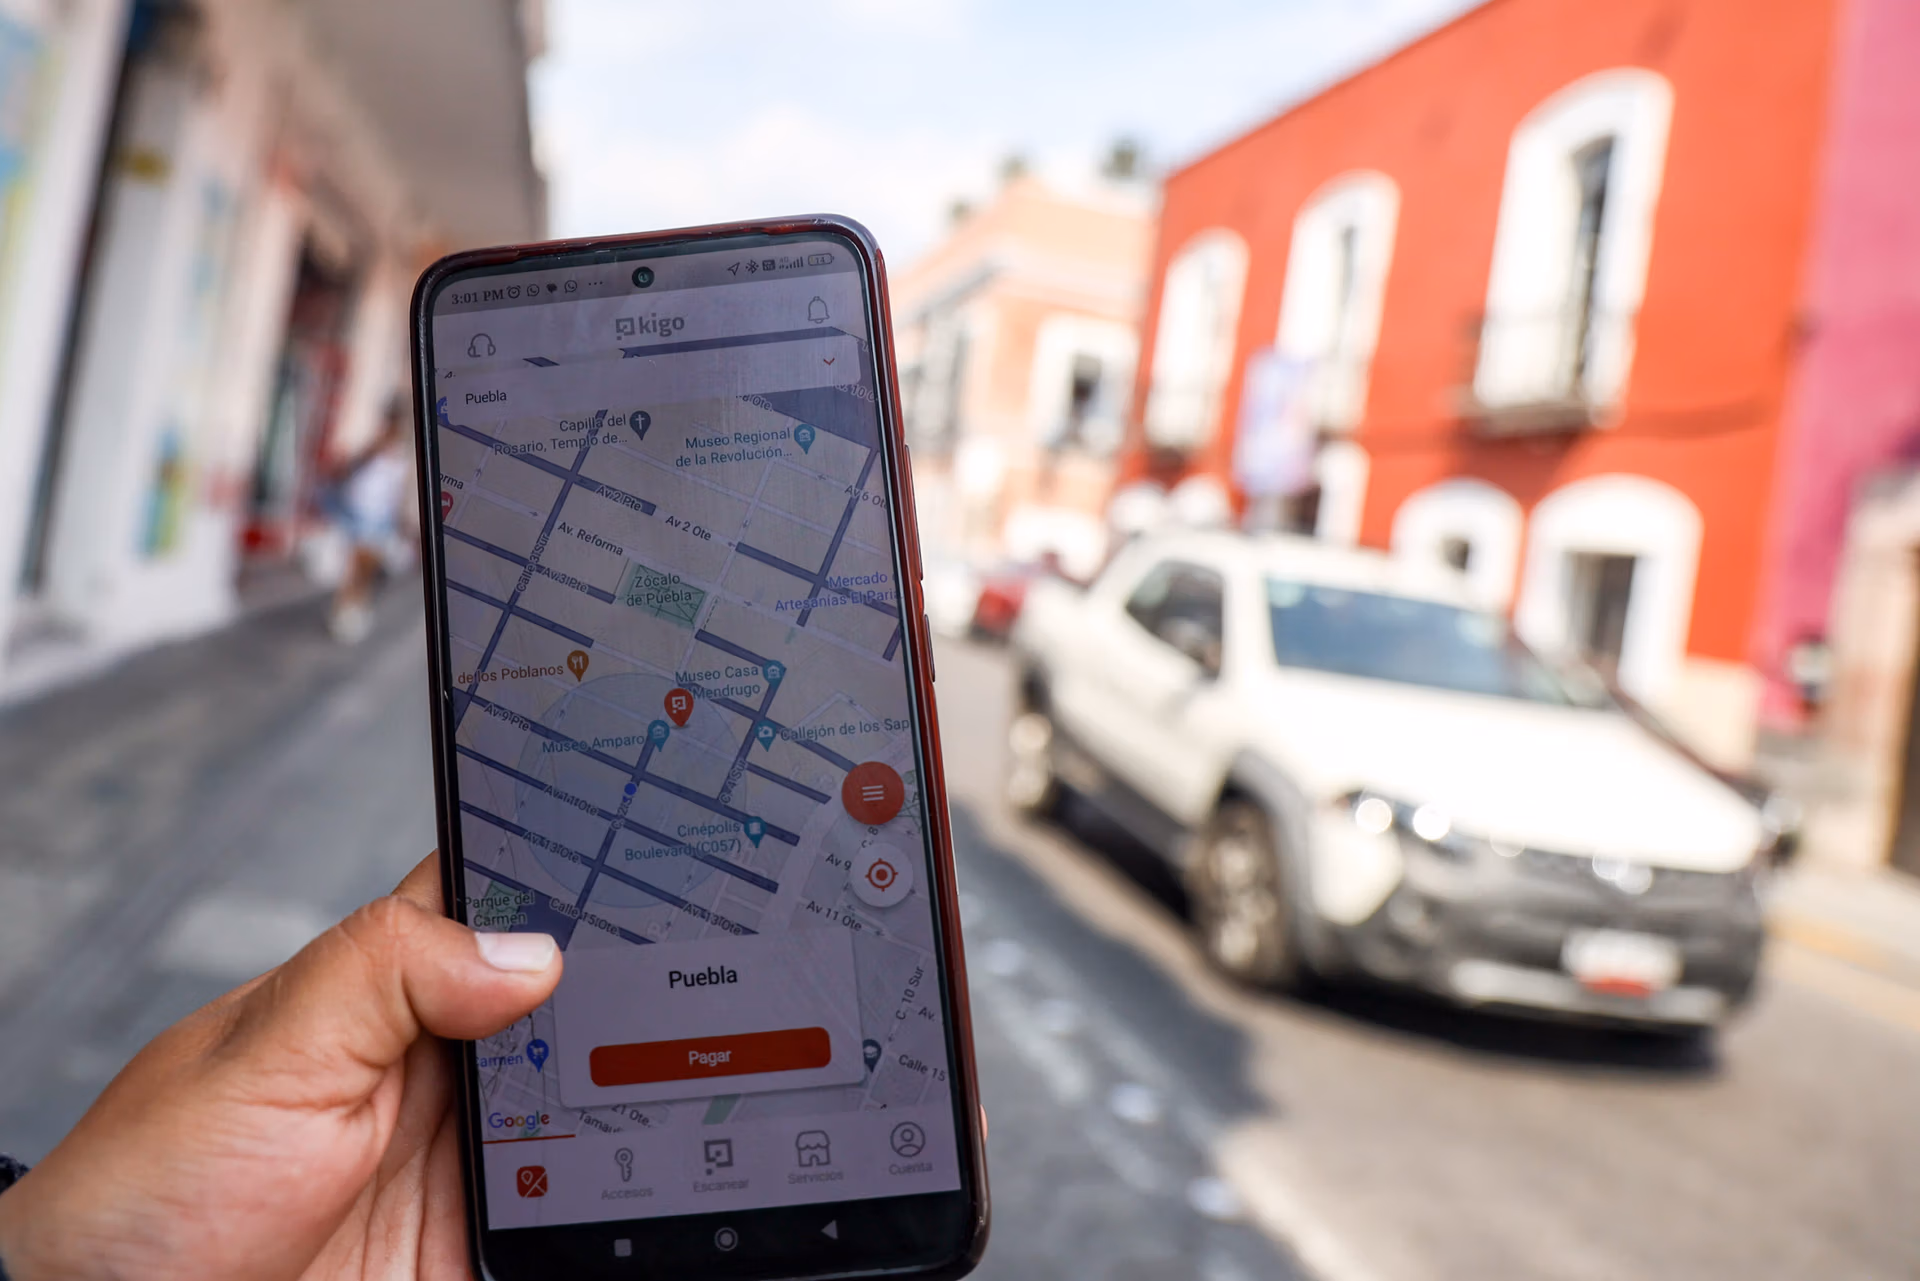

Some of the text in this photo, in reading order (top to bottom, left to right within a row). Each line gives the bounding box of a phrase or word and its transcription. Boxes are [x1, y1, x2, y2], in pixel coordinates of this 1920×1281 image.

[451, 288, 504, 305] 3:01 PM
[639, 312, 685, 337] kigo
[465, 389, 507, 405] Puebla
[559, 414, 627, 433] Capilla del
[494, 440, 547, 456] Rosario,
[550, 434, 598, 451] Templo
[685, 427, 790, 450] Museo Regional
[675, 454, 691, 468] de
[695, 452, 707, 466] la
[610, 491, 621, 503] 2
[621, 494, 642, 512] Pte
[844, 484, 861, 500] Av
[862, 490, 869, 501] 6
[665, 514, 711, 541] Av 2 Ote
[534, 535, 549, 552] Sur
[576, 528, 624, 556] Reforma
[634, 572, 680, 588] Zócalo
[829, 572, 888, 588] Mercado
[626, 589, 692, 607] de Puebla
[775, 590, 847, 612] Artesanías
[457, 664, 564, 684] de los Poblanos
[675, 665, 759, 684] Museo Casa
[692, 683, 761, 700] Mendrugo
[780, 725, 835, 742] Callejón
[839, 722, 856, 735] de
[859, 720, 880, 733] los
[542, 735, 644, 753] Museo Amparo
[678, 822, 741, 839] Cinépolis
[625, 839, 742, 861] Boulevard (C057)
[825, 853, 852, 871] Av 9
[465, 889, 535, 910] Parque del
[550, 897, 578, 918] Calle
[473, 911, 527, 928] Carmen
[806, 901, 862, 932] Av 11 Ote
[668, 965, 738, 989] Puebla
[908, 965, 925, 988] Sur
[901, 988, 916, 1005] 10
[688, 1049, 732, 1068] Pagar
[898, 1053, 946, 1082] Calle 15
[488, 1110, 550, 1132] Google
[787, 1170, 844, 1185] Servicios
[889, 1161, 933, 1176] Cuenta
[601, 1186, 654, 1201] Accesos
[693, 1178, 750, 1193] Escanear
